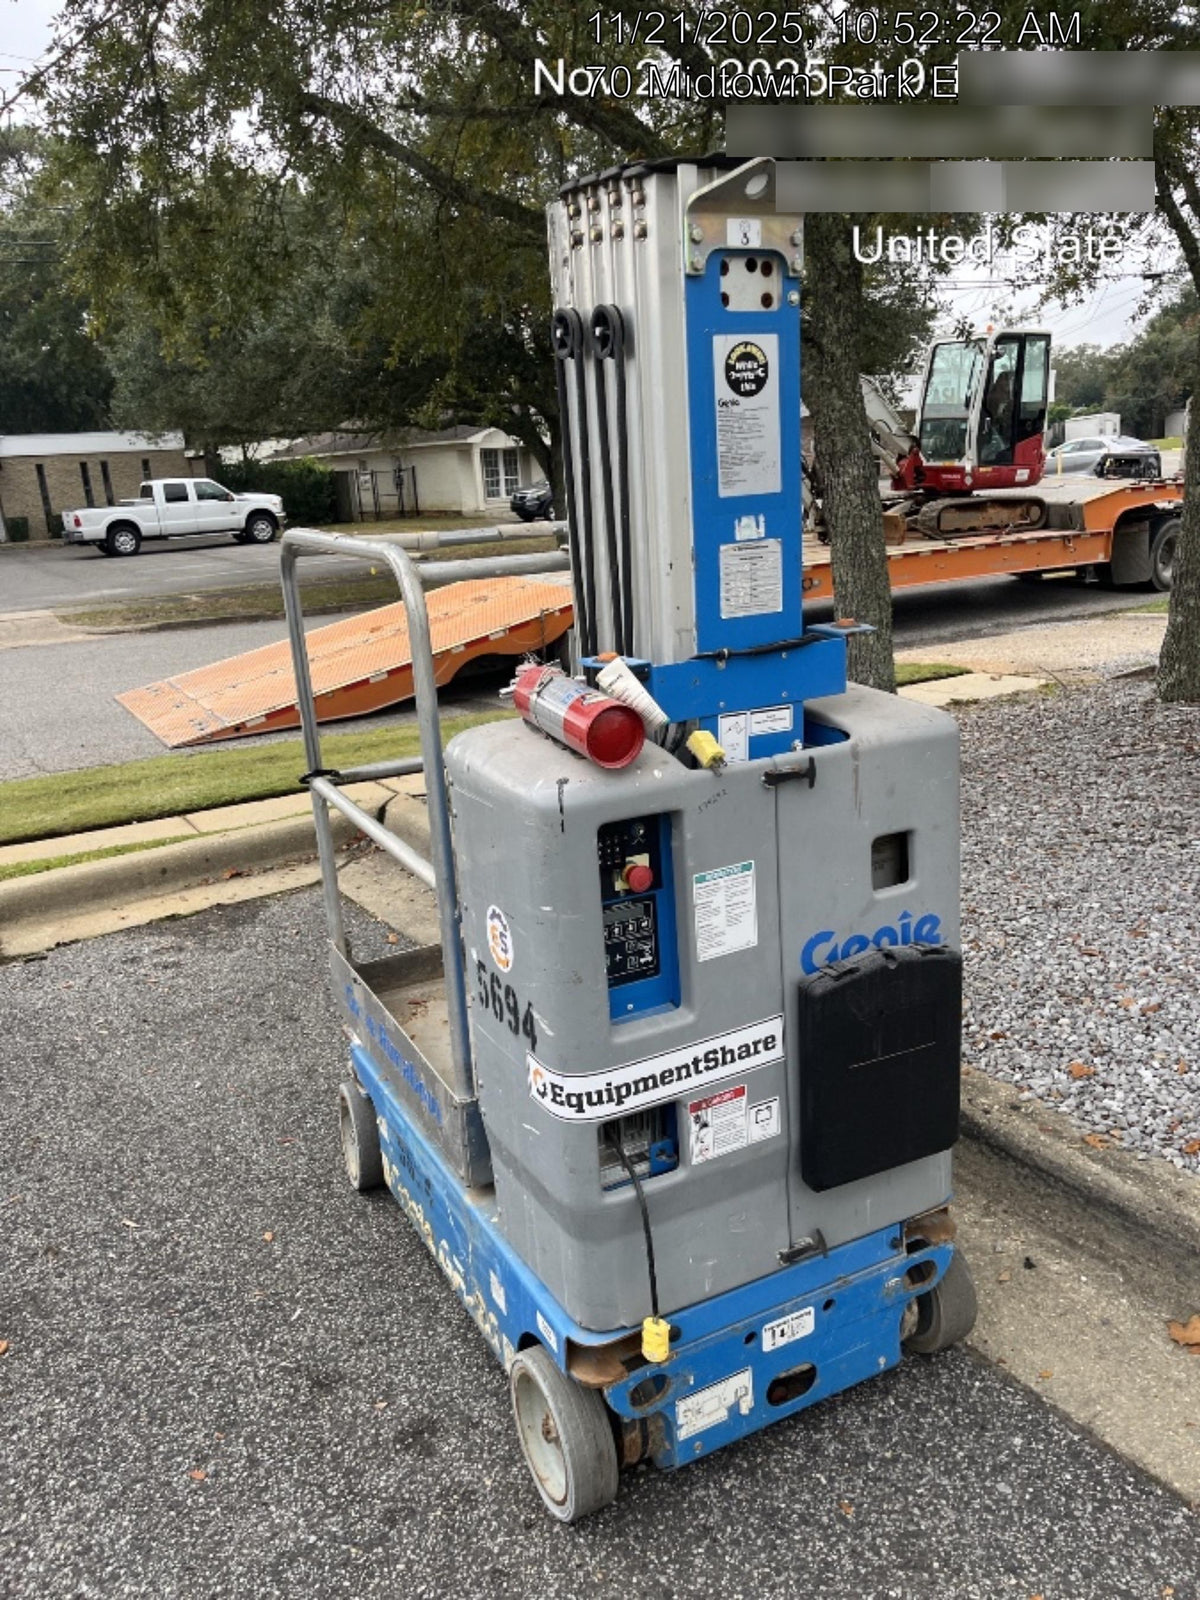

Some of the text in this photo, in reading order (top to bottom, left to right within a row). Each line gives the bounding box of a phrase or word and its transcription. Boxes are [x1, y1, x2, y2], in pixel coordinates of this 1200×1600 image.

[801, 910, 941, 976] Genie
[476, 959, 538, 1054] 5694
[551, 1033, 777, 1113] EquipmentShare
